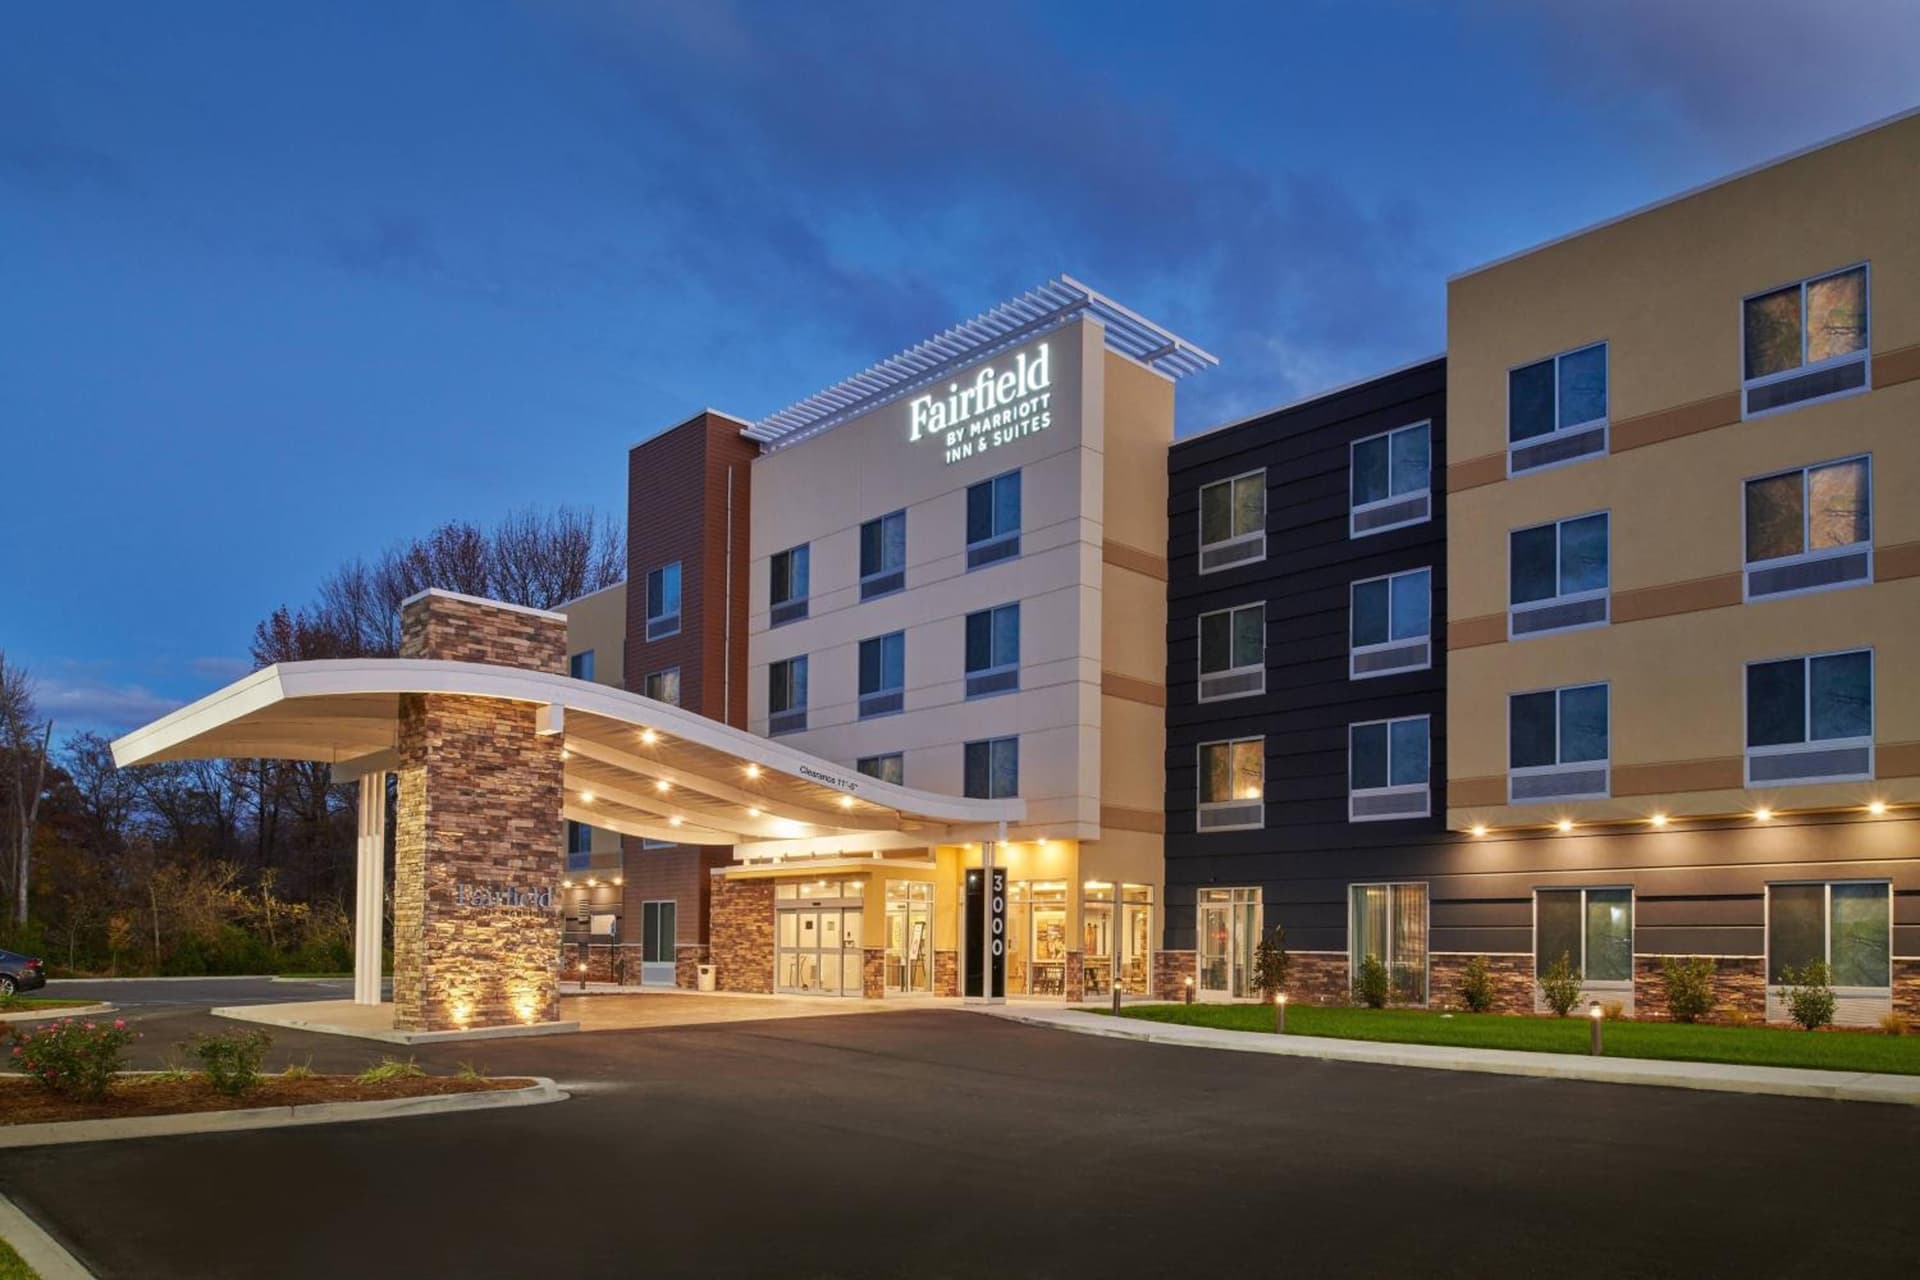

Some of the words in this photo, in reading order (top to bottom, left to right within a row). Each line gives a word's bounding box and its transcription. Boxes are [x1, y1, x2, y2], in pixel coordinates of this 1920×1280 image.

[909, 343, 1051, 442] Fairfield
[946, 427, 965, 446] BY
[970, 393, 1051, 437] MARRIOTT
[946, 442, 972, 463] INN
[978, 437, 988, 452] &
[993, 412, 1051, 446] SUITES
[800, 765, 836, 784] Clearance
[455, 883, 553, 907] Fairfield
[991, 874, 1003, 956] 3000
